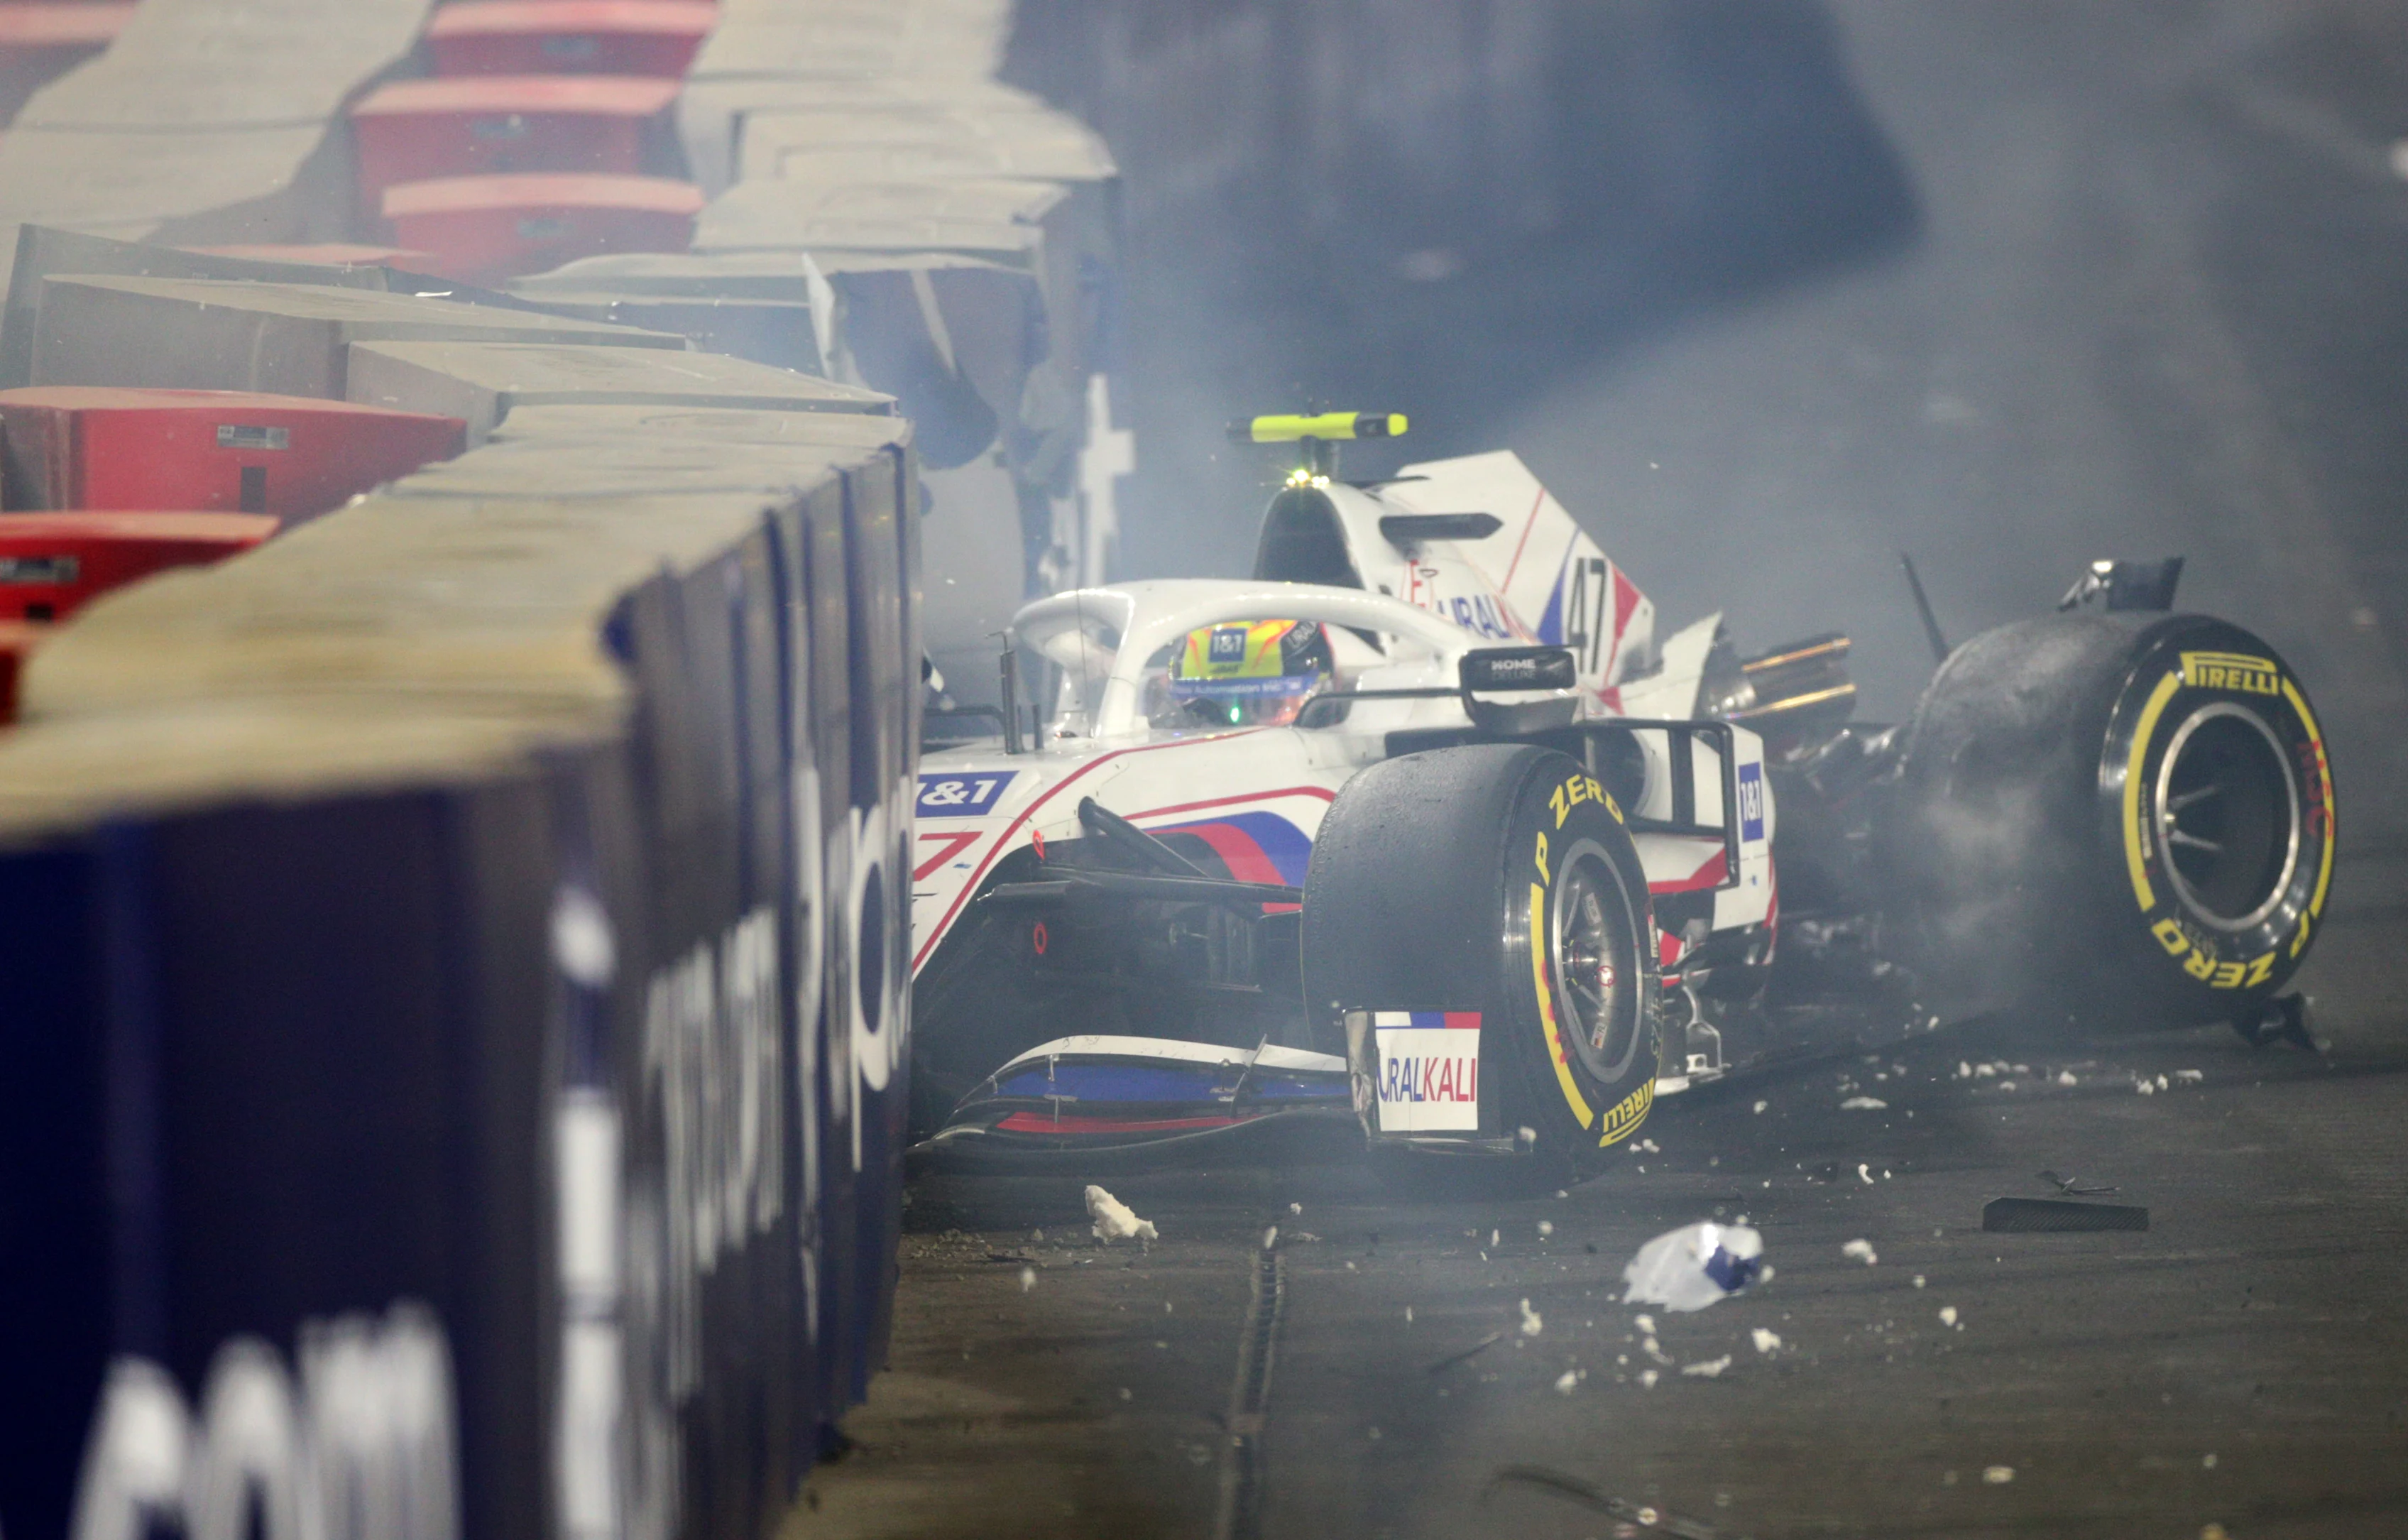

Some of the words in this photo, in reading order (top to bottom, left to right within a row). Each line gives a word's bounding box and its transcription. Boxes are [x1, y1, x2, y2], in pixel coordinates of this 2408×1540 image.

[1567, 557, 1607, 675] 47
[1492, 659, 1536, 670] HOME
[2179, 651, 2279, 696] PIRELLI
[1741, 779, 1761, 821] 1&1
[1535, 831, 1550, 887] P
[1549, 774, 1624, 830] ZERO
[2152, 918, 2276, 989] ZERO
[2289, 910, 2310, 959] P
[1377, 1056, 1477, 1103] URALKALI
